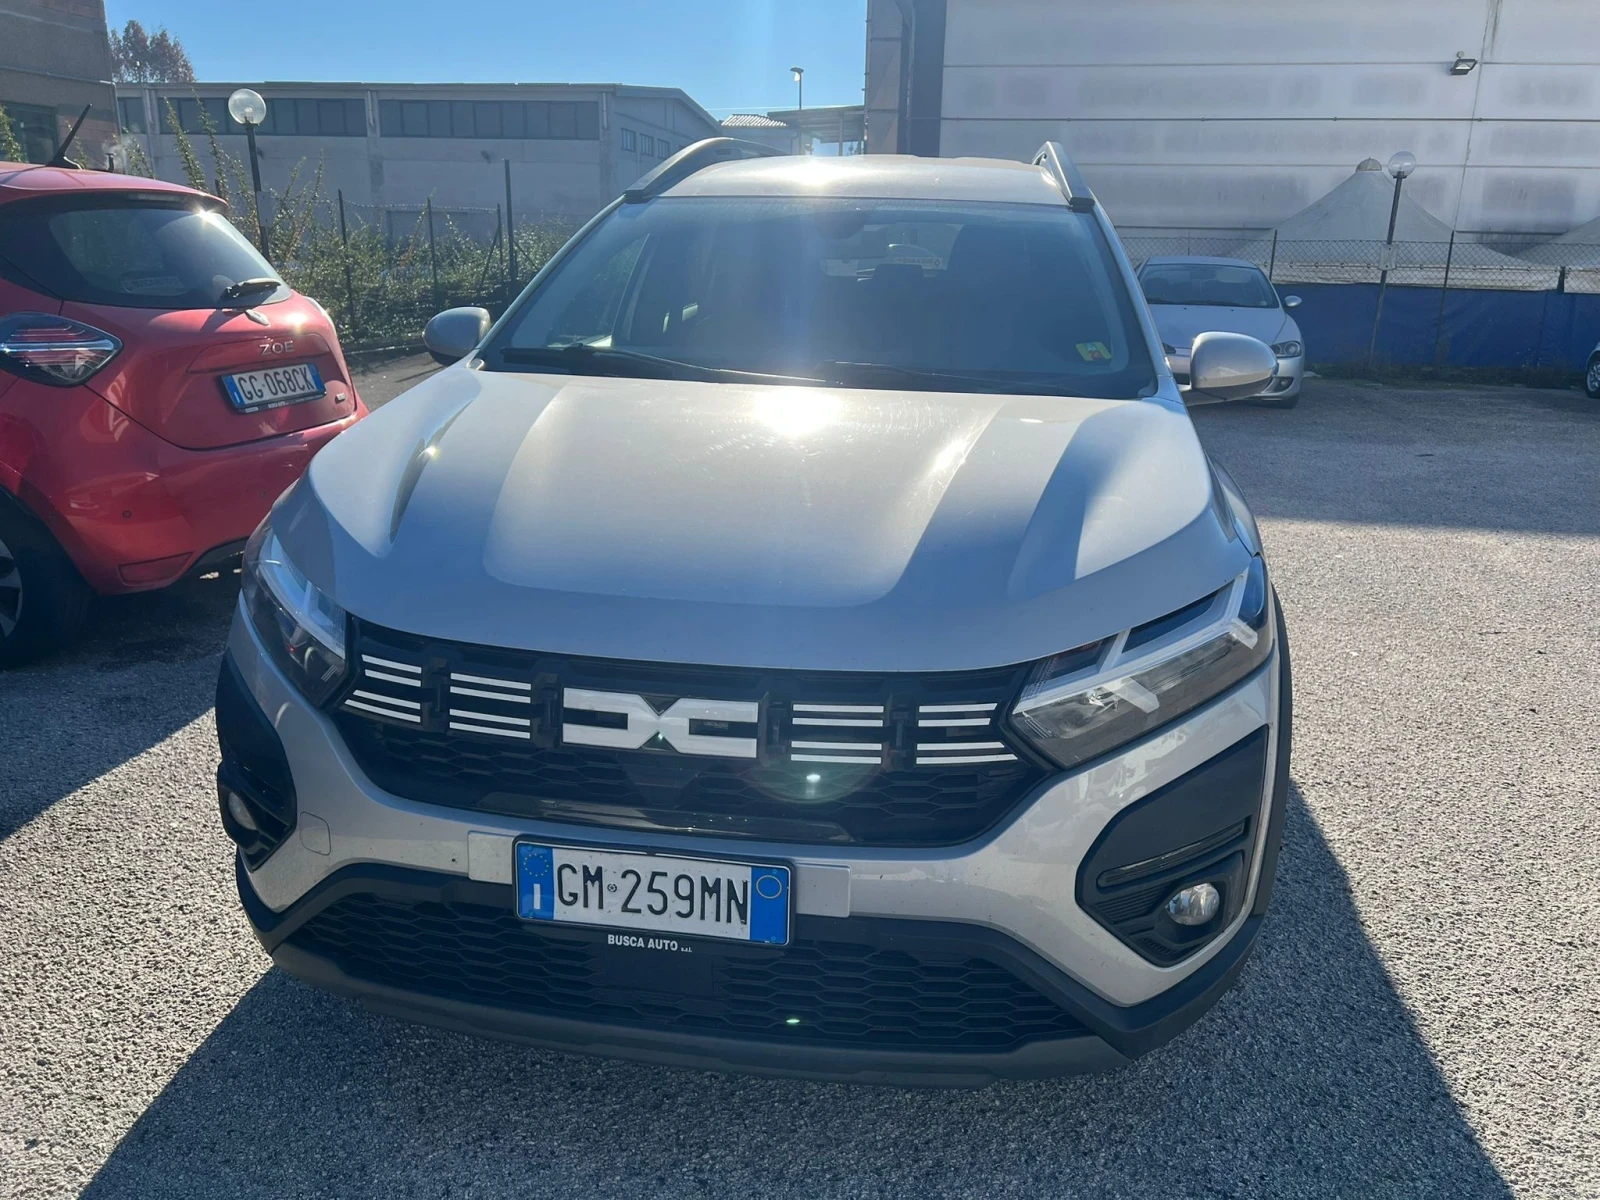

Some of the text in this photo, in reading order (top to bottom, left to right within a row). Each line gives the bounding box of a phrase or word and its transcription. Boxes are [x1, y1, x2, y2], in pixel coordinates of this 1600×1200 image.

[259, 341, 294, 355] ZOE
[533, 883, 541, 910] I
[556, 863, 750, 926] GM 259MN
[607, 934, 645, 948] BUSCA
[647, 938, 679, 951] AUTO
